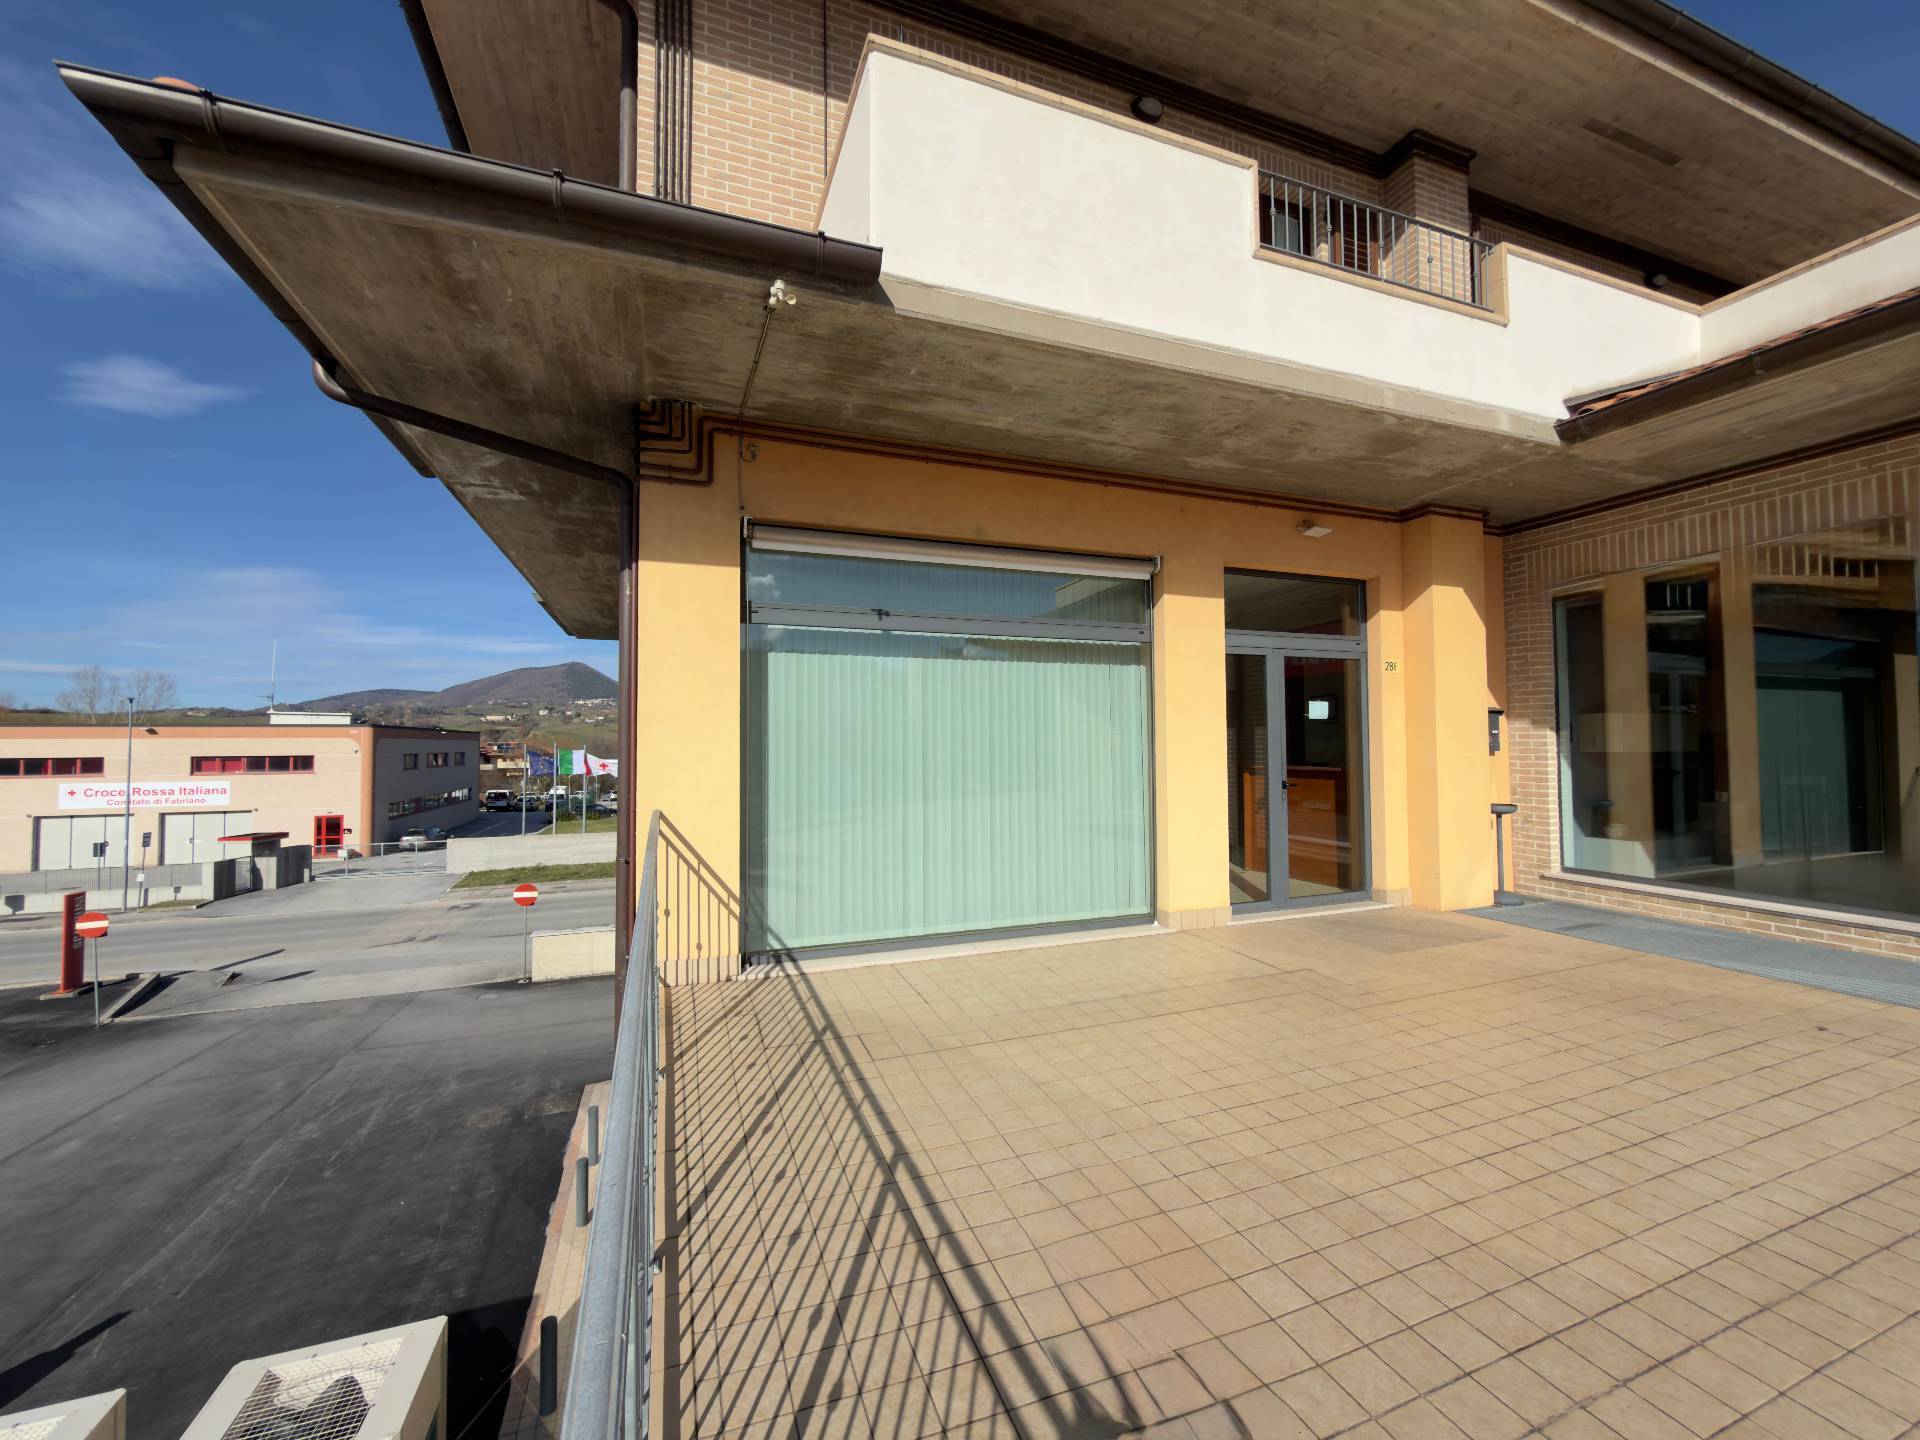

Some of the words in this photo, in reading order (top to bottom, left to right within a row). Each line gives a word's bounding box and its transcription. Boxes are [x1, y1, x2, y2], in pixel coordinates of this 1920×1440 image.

[83, 788, 126, 798] Croce
[132, 787, 175, 797] Rossa
[179, 786, 228, 796] Italiana
[165, 797, 206, 805] Fabriano
